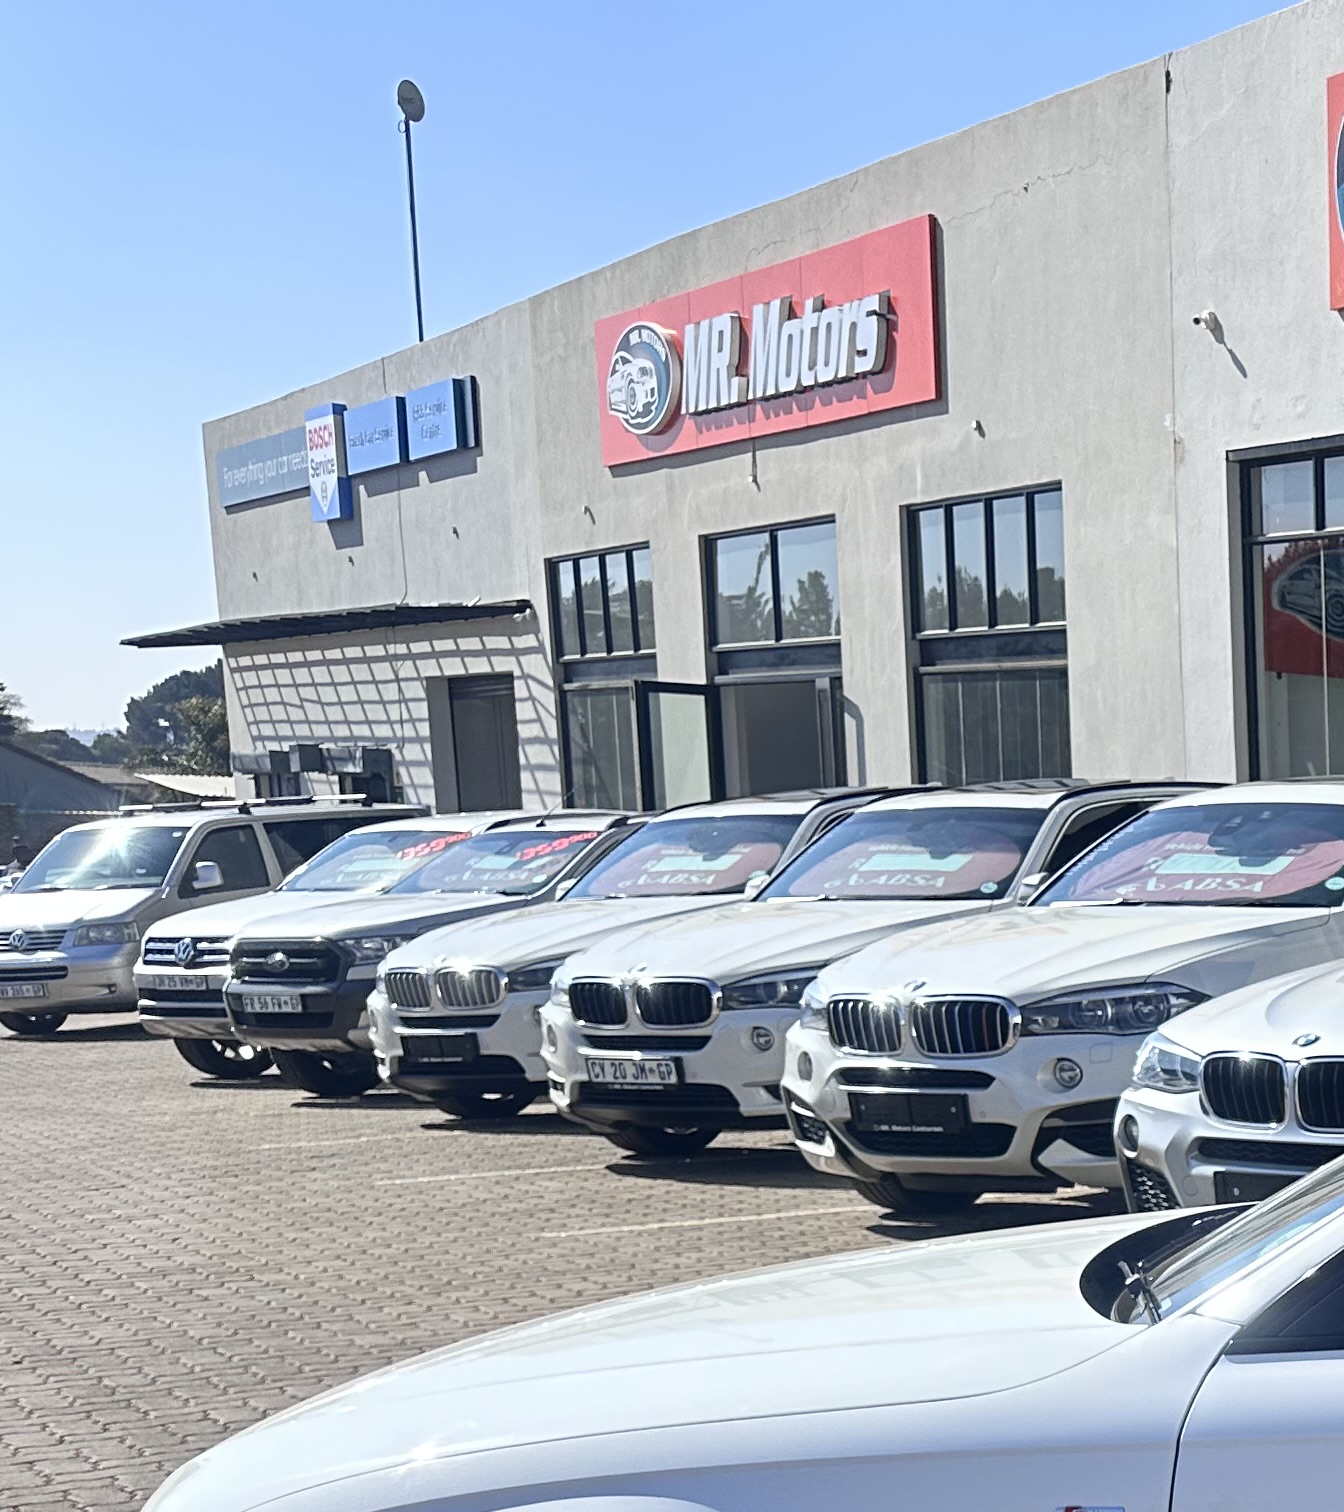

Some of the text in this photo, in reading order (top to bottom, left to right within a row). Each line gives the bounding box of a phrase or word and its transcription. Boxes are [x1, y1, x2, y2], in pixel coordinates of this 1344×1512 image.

[681, 289, 892, 416] MR. Motors
[308, 423, 334, 452] BOSCH
[310, 454, 336, 479] Service
[865, 872, 946, 888] ABSA
[1171, 877, 1265, 893] ABSA
[591, 1061, 673, 1081] CY 20 JM GP
